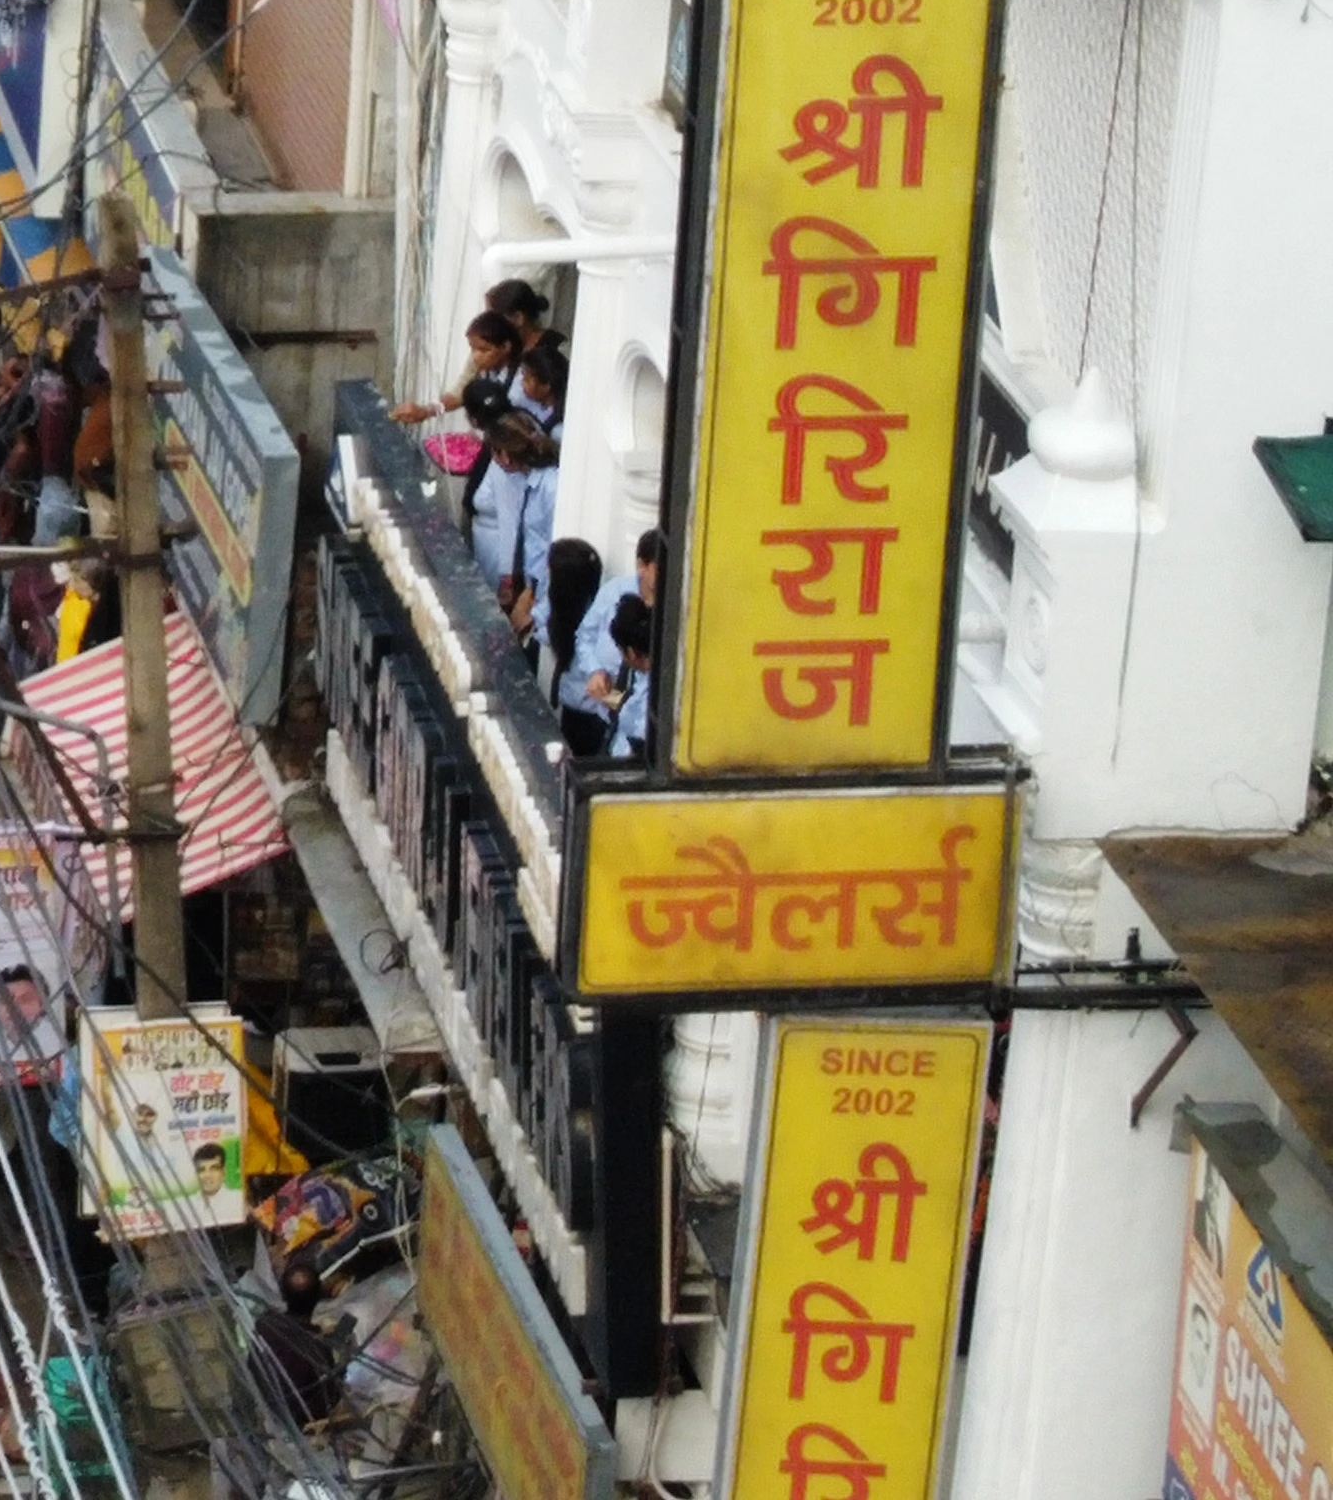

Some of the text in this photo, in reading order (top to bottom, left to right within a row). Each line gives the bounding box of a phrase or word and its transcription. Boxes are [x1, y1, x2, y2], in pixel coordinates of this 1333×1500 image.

[778, 54, 944, 189] श्री
[619, 824, 978, 954] ज्वैलर्स
[820, 1048, 936, 1078] SINCE
[832, 1088, 916, 1117] 2002
[800, 1142, 928, 1264] श्री
